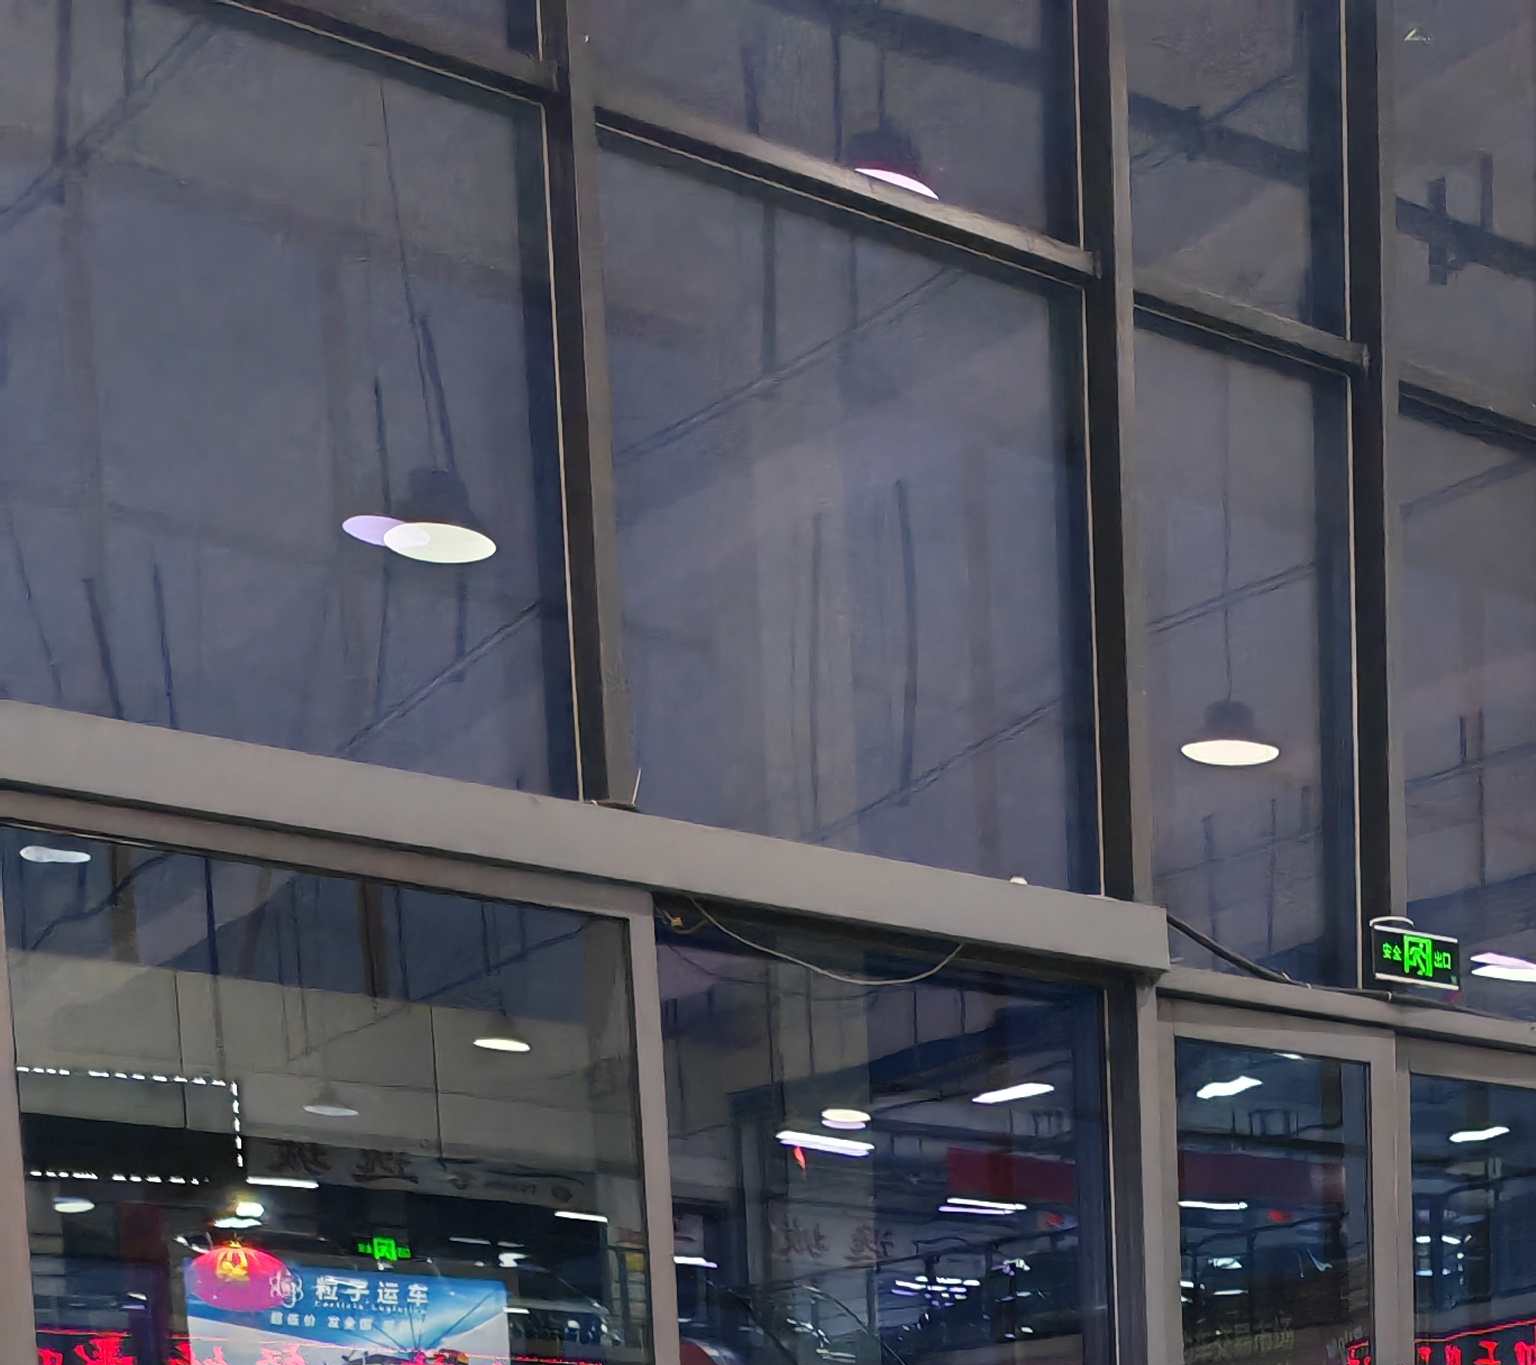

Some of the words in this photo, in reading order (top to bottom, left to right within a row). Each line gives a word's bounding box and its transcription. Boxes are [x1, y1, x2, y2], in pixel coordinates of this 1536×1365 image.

[1382, 942, 1402, 961] 安全
[1434, 950, 1451, 969] 出口
[314, 1275, 429, 1305] 粒子运车
